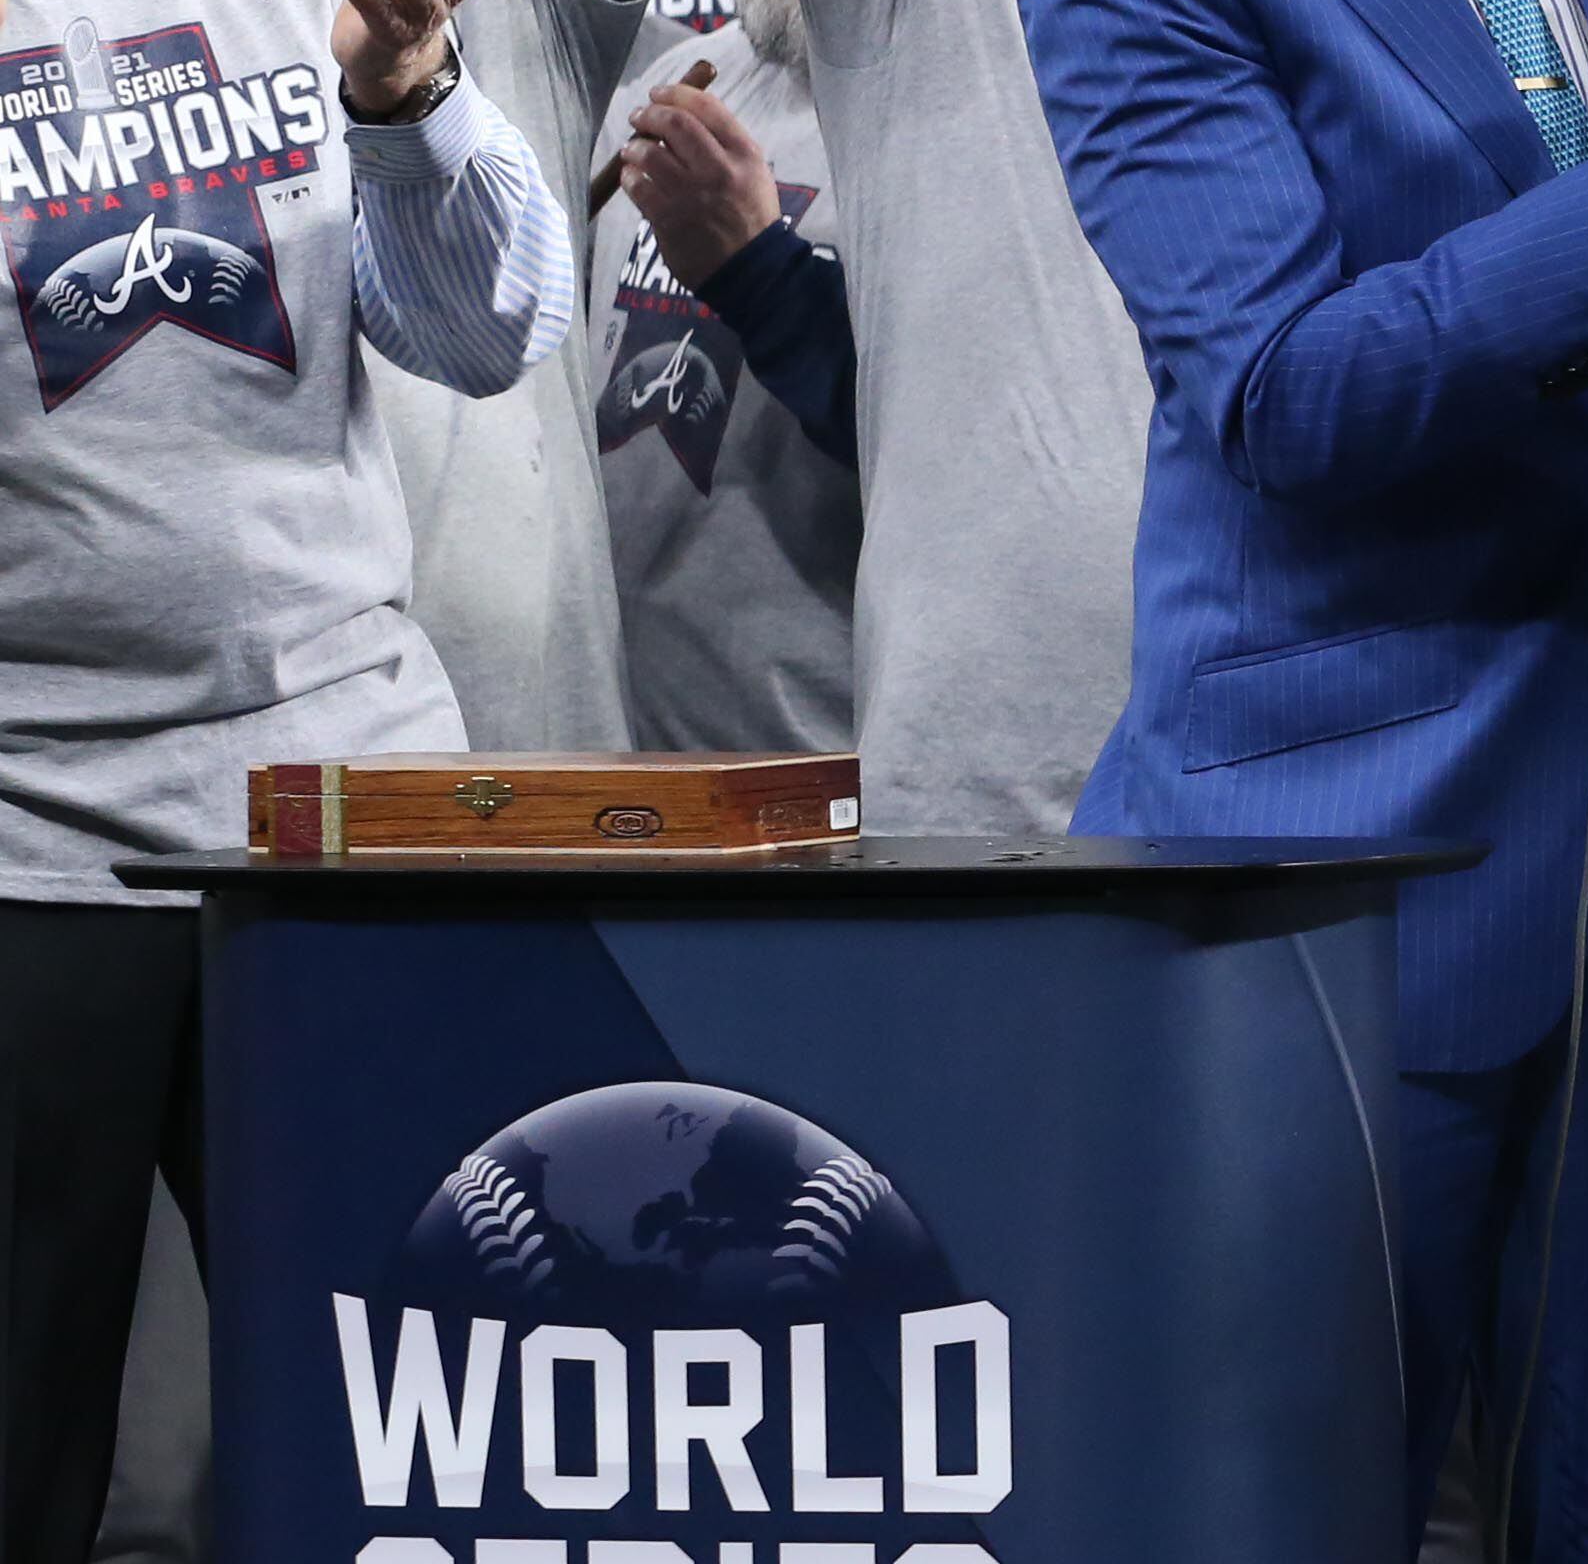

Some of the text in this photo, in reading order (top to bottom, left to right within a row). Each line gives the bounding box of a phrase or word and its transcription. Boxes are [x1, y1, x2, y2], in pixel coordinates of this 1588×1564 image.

[20, 52, 152, 85] 20 21
[115, 61, 208, 107] SERIES
[0, 65, 328, 202] AMPIONS
[150, 149, 309, 200] BRAVES
[93, 213, 193, 316] A
[332, 1292, 1013, 1514] WORLD
